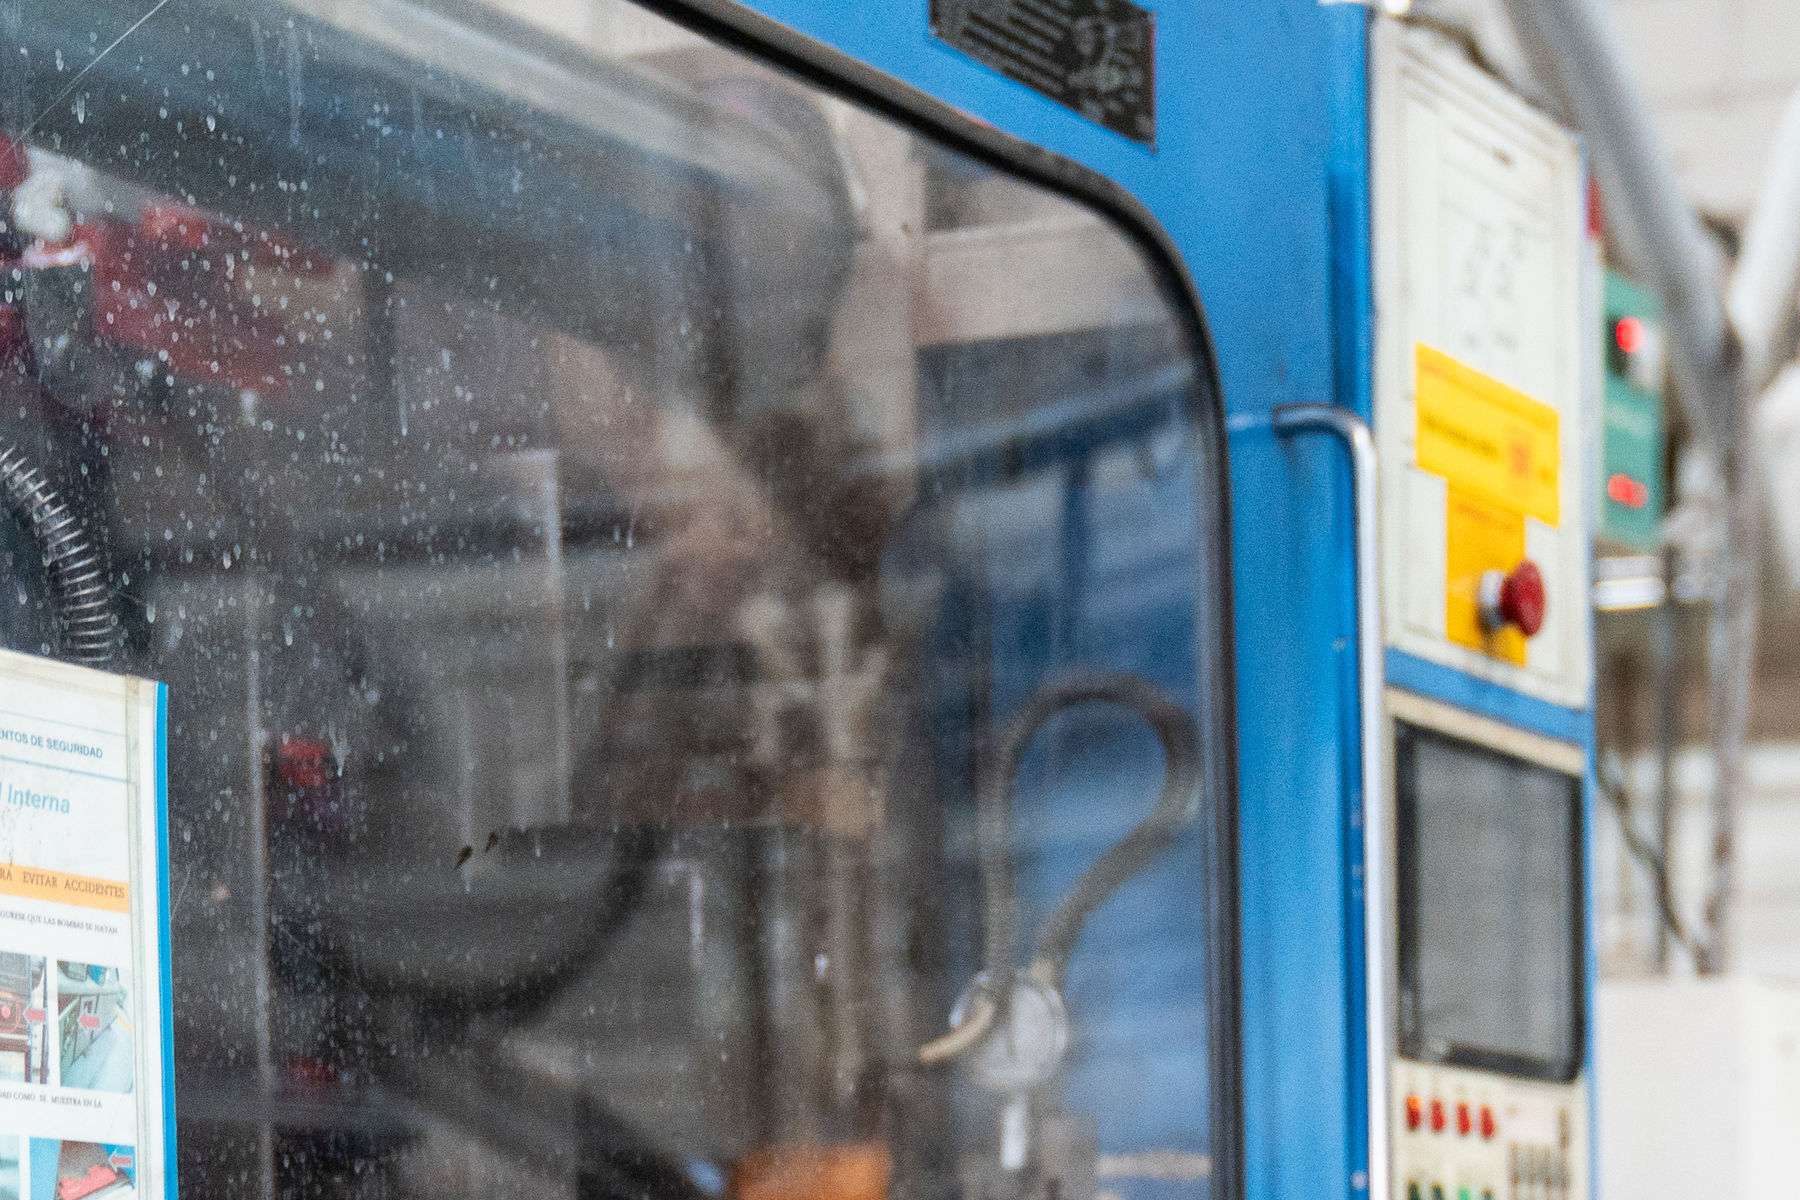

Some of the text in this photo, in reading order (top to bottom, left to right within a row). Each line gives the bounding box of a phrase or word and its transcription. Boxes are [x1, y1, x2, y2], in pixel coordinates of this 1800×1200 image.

[30, 734, 43, 748] DE
[46, 738, 103, 759] SEGURIDAD
[8, 783, 70, 814] Interna
[23, 871, 58, 888] EVITAR
[64, 879, 125, 898] ACCIDENTES
